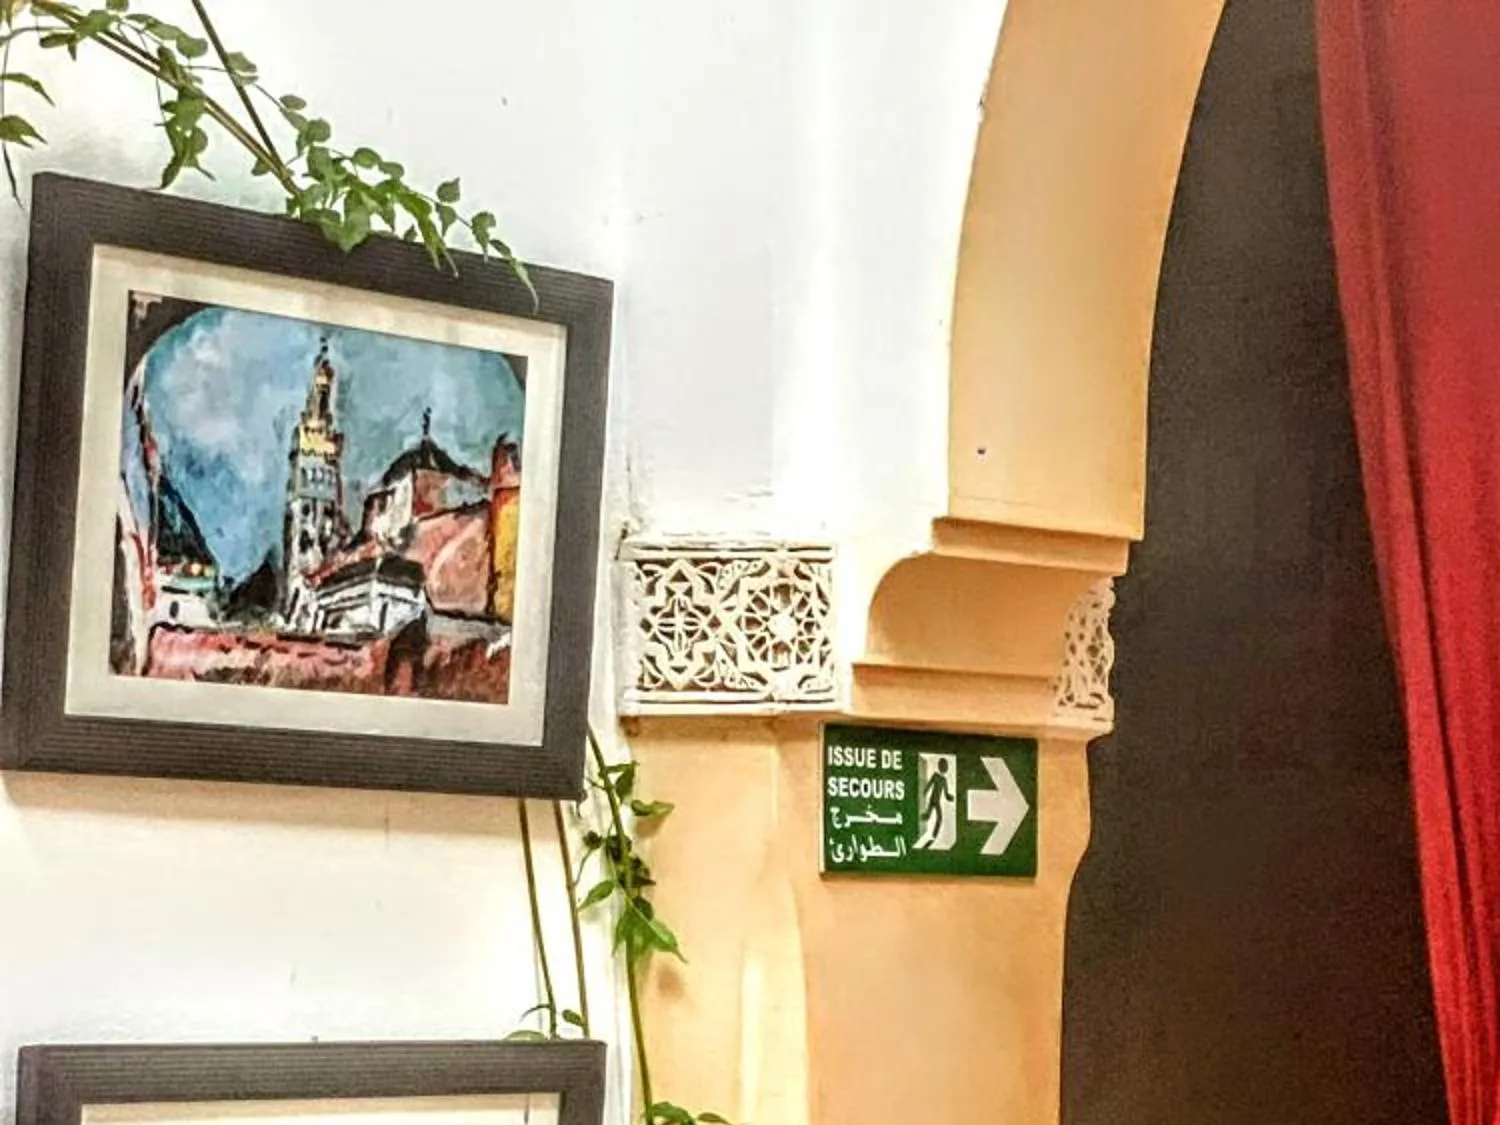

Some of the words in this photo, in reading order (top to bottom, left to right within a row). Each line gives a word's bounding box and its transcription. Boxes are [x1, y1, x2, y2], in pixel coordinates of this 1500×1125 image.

[828, 745, 877, 768] ISSUE
[881, 748, 903, 770] DE
[828, 776, 905, 800] SECOURS
